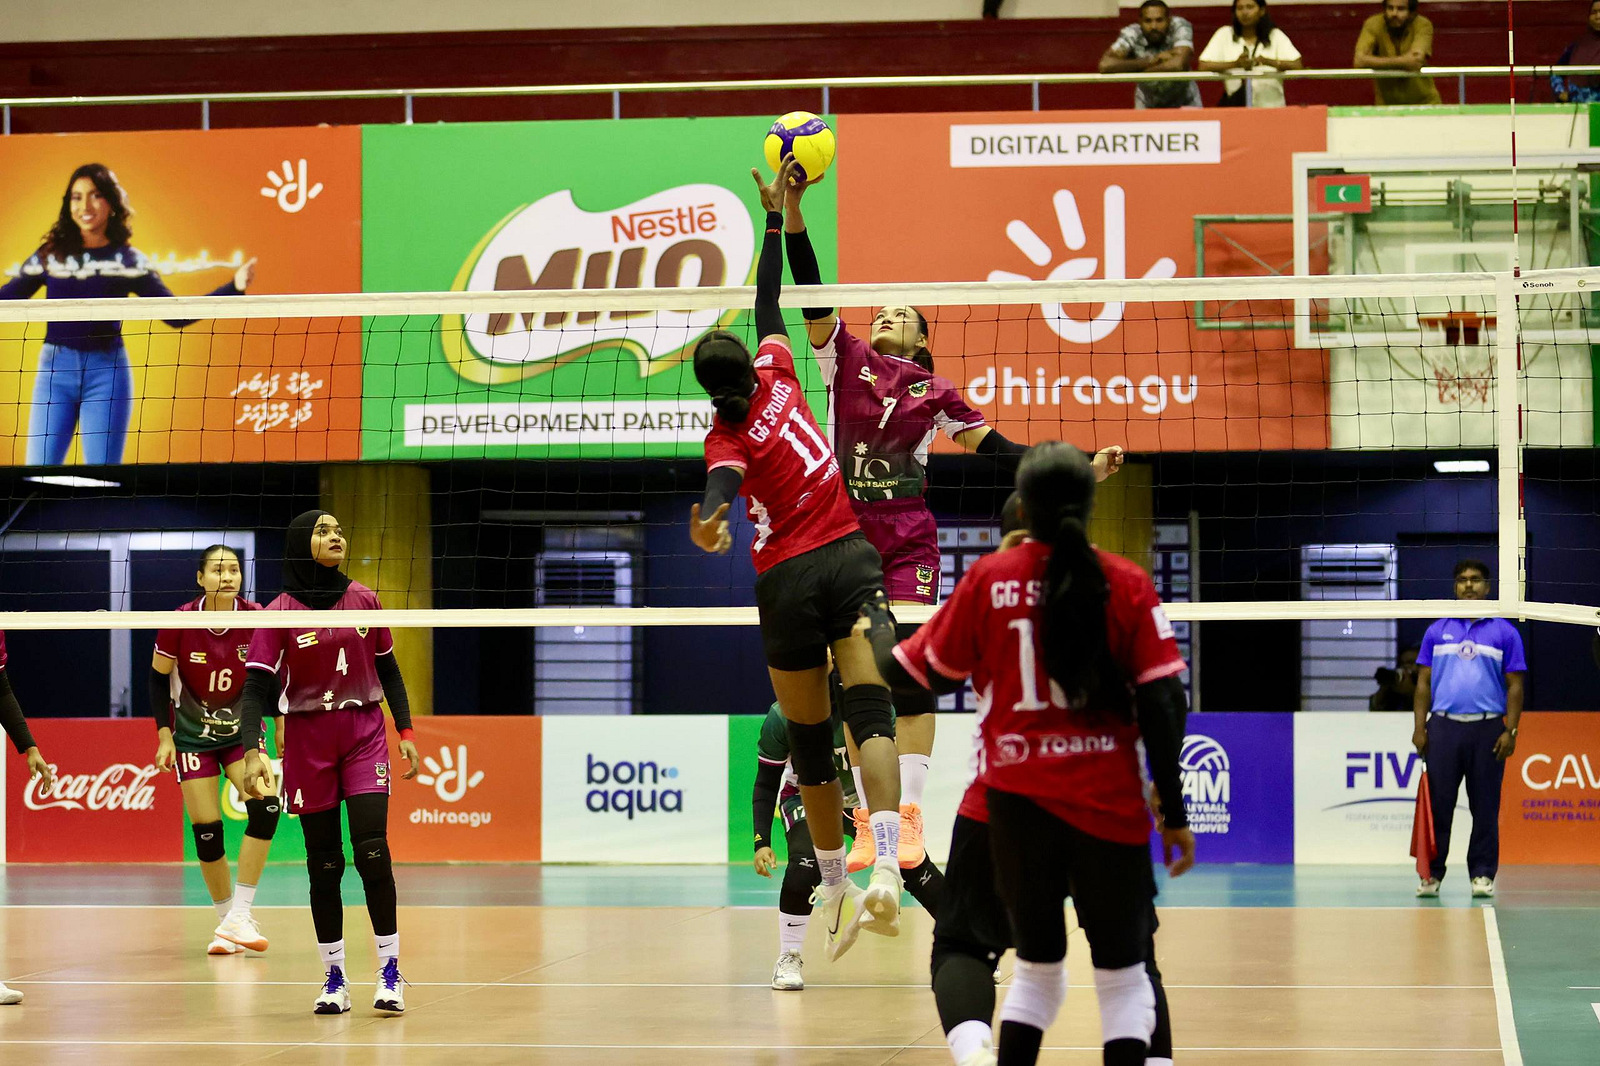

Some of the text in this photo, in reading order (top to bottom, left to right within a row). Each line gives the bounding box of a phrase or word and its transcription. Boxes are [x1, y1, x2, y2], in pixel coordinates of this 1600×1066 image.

[970, 132, 1200, 156] DIGITAL PARTNER
[486, 237, 728, 336] MILO
[967, 366, 1198, 415] dhiraagu
[421, 411, 712, 435] DEVELOPMENT PARTN
[878, 396, 898, 430] 7
[335, 647, 349, 676] 4
[208, 668, 233, 692] 16
[181, 752, 201, 773] 16
[587, 753, 658, 785] bon
[1346, 752, 1423, 789] FIV
[23, 763, 161, 811] Coca-Cola
[293, 788, 304, 808] 4
[1179, 770, 1231, 803] AM
[409, 808, 492, 828] dhiraagu
[585, 788, 683, 821] aqua
[1184, 803, 1228, 813] LEYBALL
[1188, 823, 1229, 834] ALDIVES
